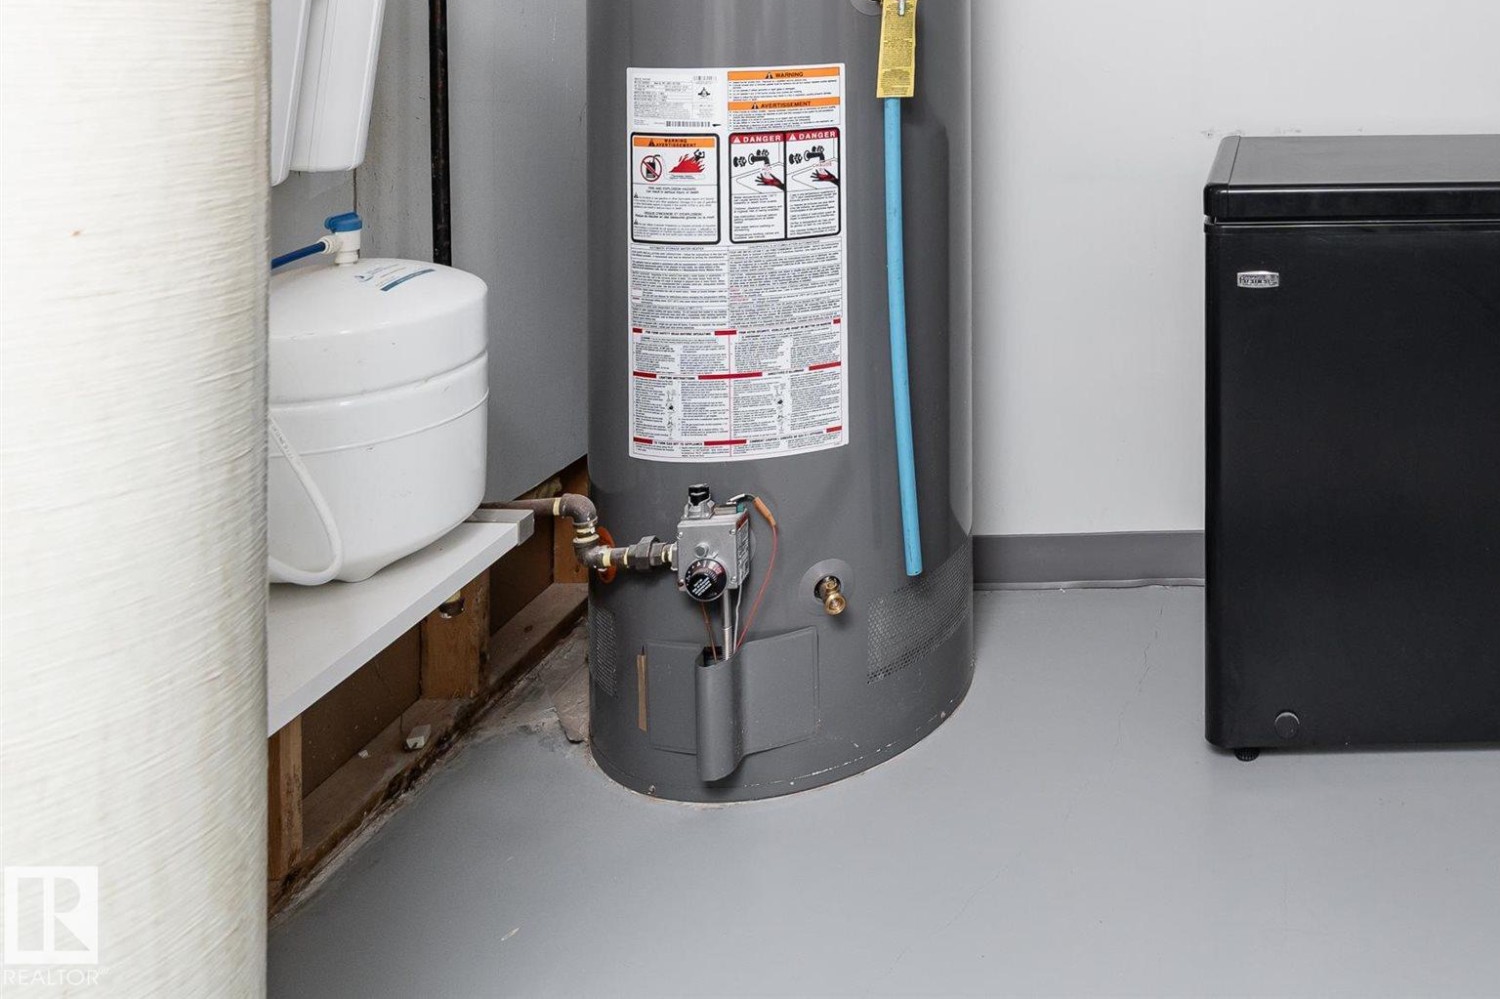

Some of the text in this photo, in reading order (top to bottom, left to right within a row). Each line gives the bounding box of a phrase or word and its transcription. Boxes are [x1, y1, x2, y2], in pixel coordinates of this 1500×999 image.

[760, 101, 811, 109] AVERTISSEMENT
[743, 135, 781, 143] DANGER
[798, 131, 836, 140] DANGER
